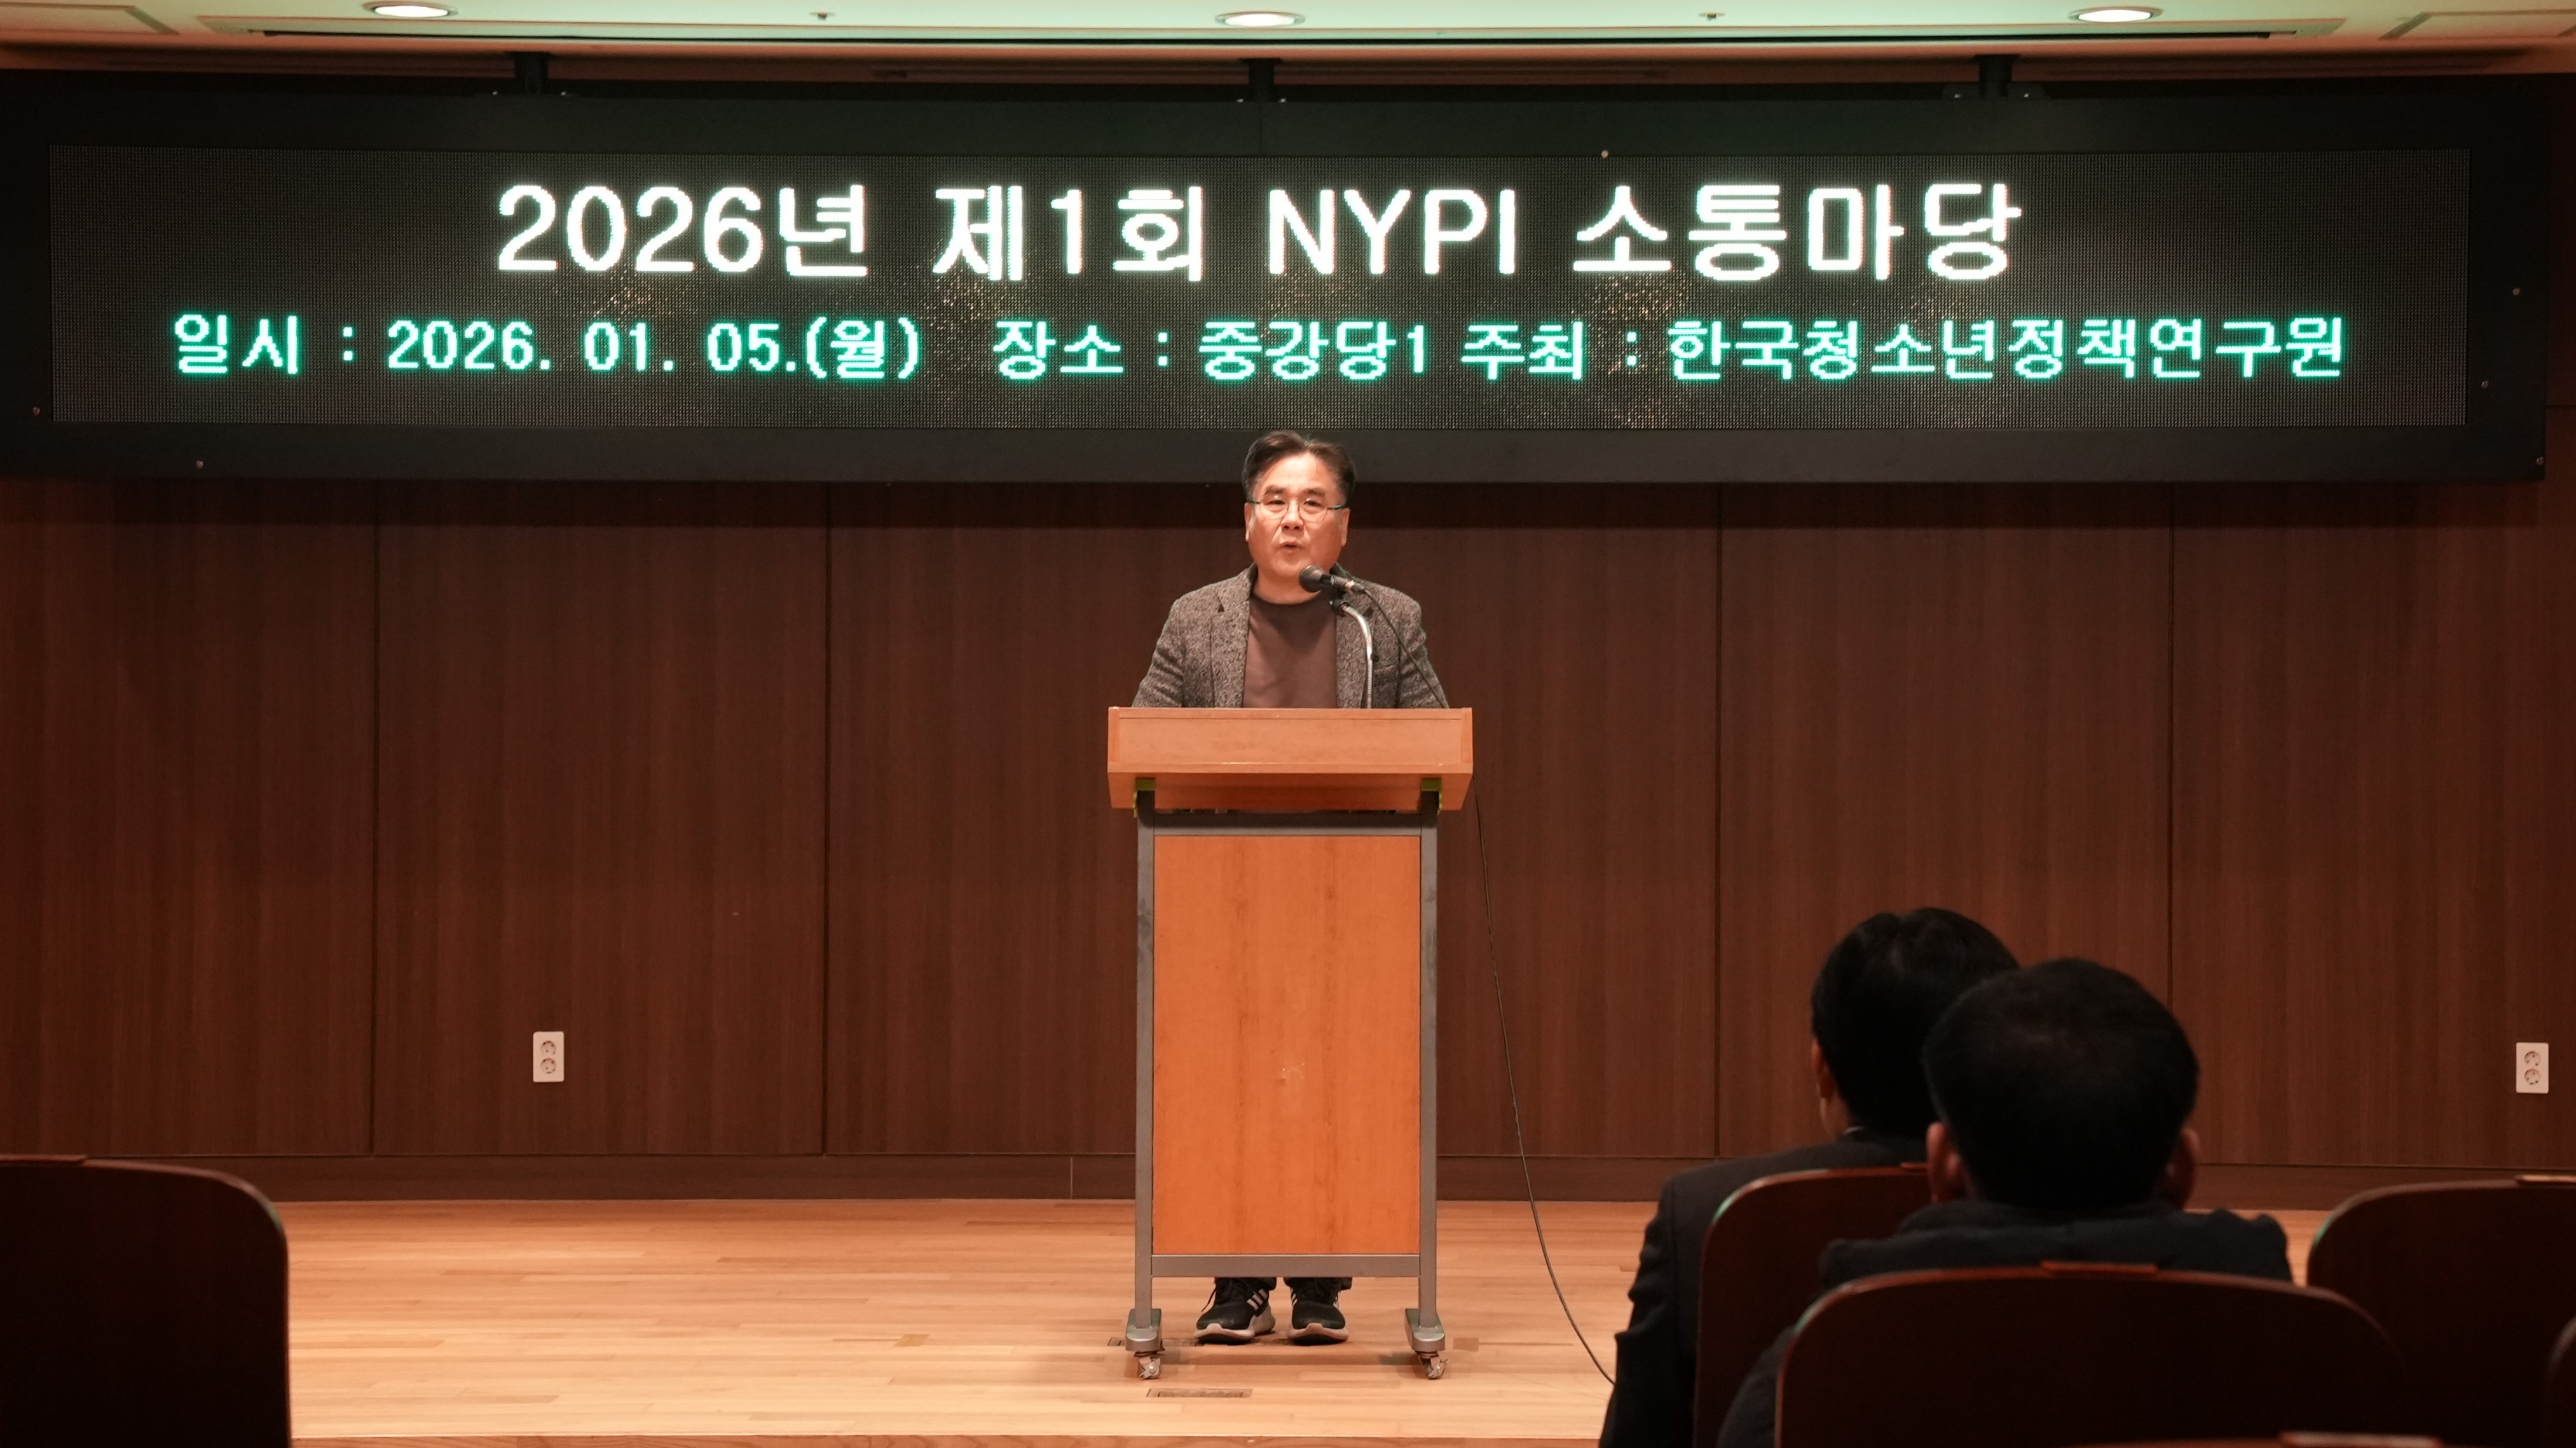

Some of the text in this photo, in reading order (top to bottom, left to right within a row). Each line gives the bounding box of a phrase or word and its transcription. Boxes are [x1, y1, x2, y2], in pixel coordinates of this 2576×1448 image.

[497, 182, 2023, 285] 2026년 제1회 NYPI 소통마당
[173, 313, 301, 376] 일시
[387, 318, 552, 372] 2026.
[583, 320, 676, 373] 01.
[705, 316, 921, 381] 05.(월)
[990, 317, 1125, 382] 장소
[1197, 318, 1427, 383] 중강당1
[1459, 320, 1585, 382] 주최
[1665, 315, 2345, 382] 한국청소년정책연구원
